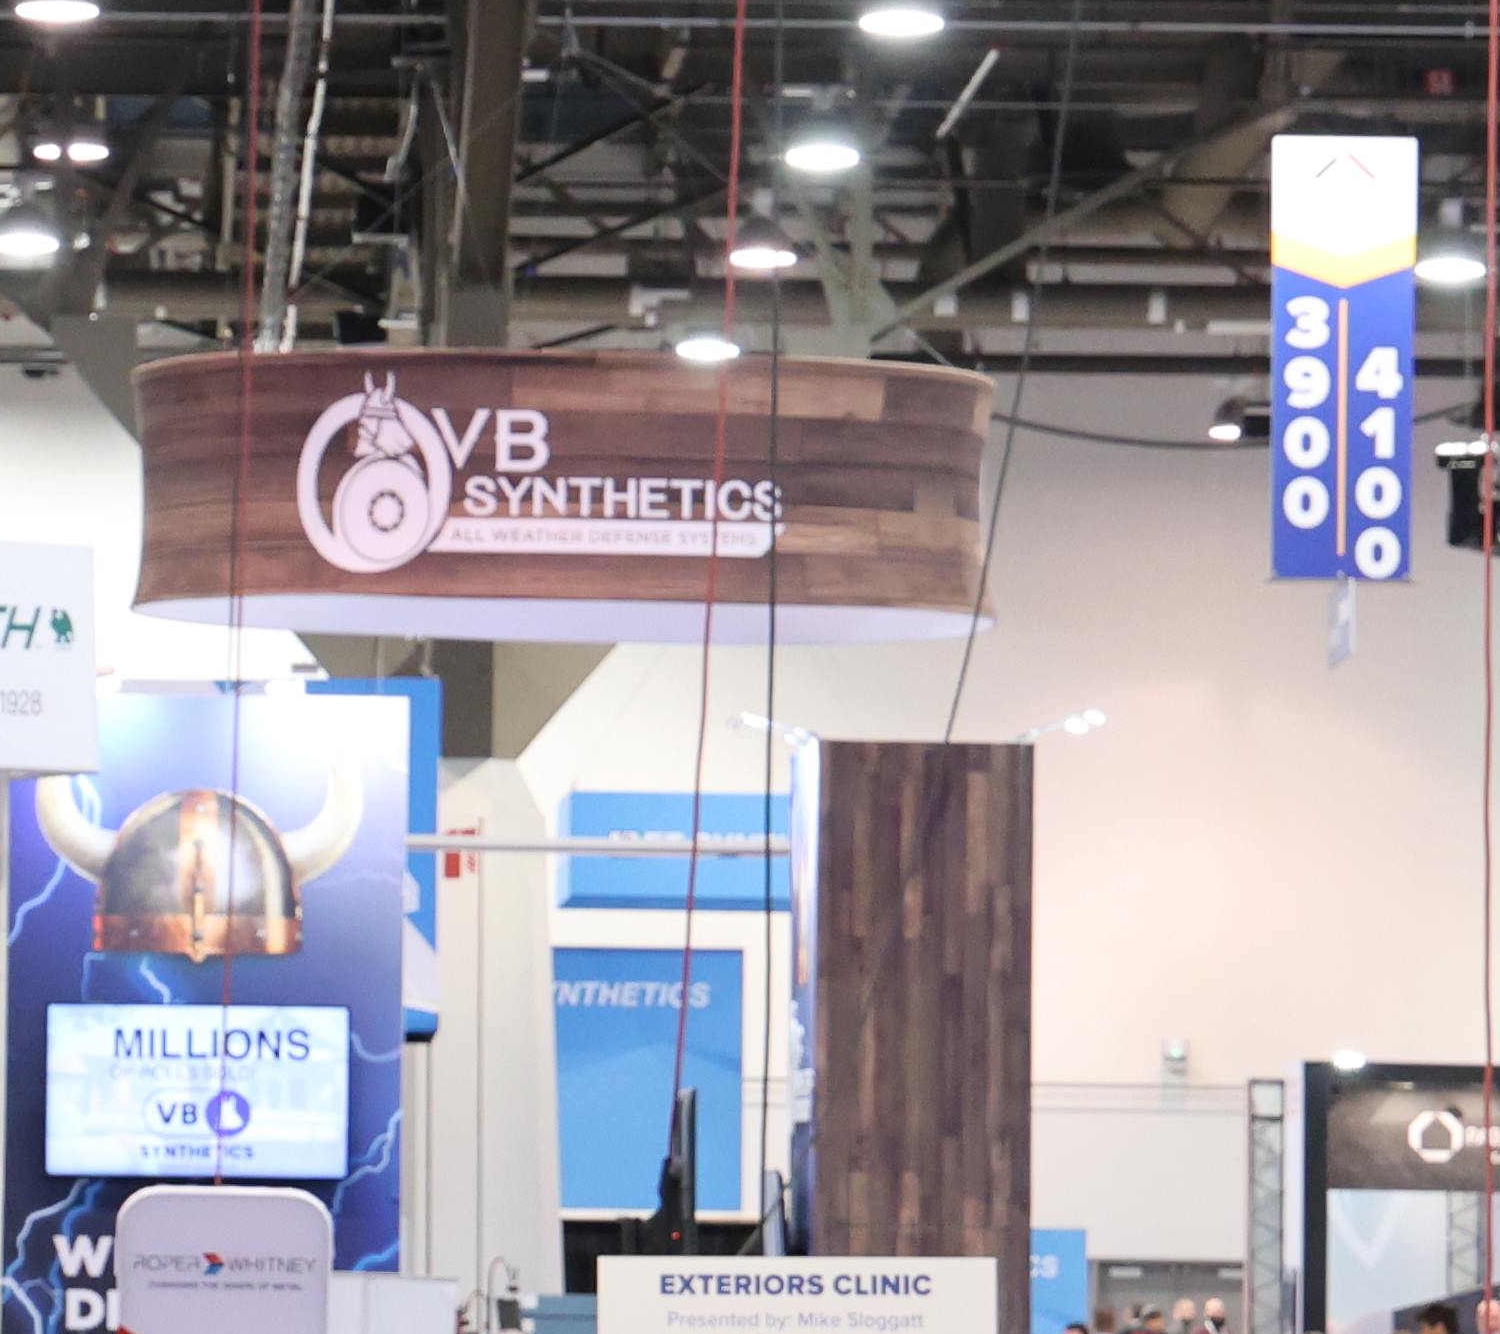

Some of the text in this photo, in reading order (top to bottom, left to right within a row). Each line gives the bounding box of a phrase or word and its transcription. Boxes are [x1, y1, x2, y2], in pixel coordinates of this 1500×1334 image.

[430, 407, 551, 471] VB
[462, 475, 783, 522] SYNTHETICS
[0, 688, 43, 718] 1928
[114, 1029, 310, 1061] MILLIONS
[157, 1103, 198, 1124] VB
[226, 1255, 316, 1274] WHITNEY
[660, 1274, 931, 1296] EXTERIORS CLINIC
[667, 1311, 923, 1331] Presented by: Mike Sloggatt
